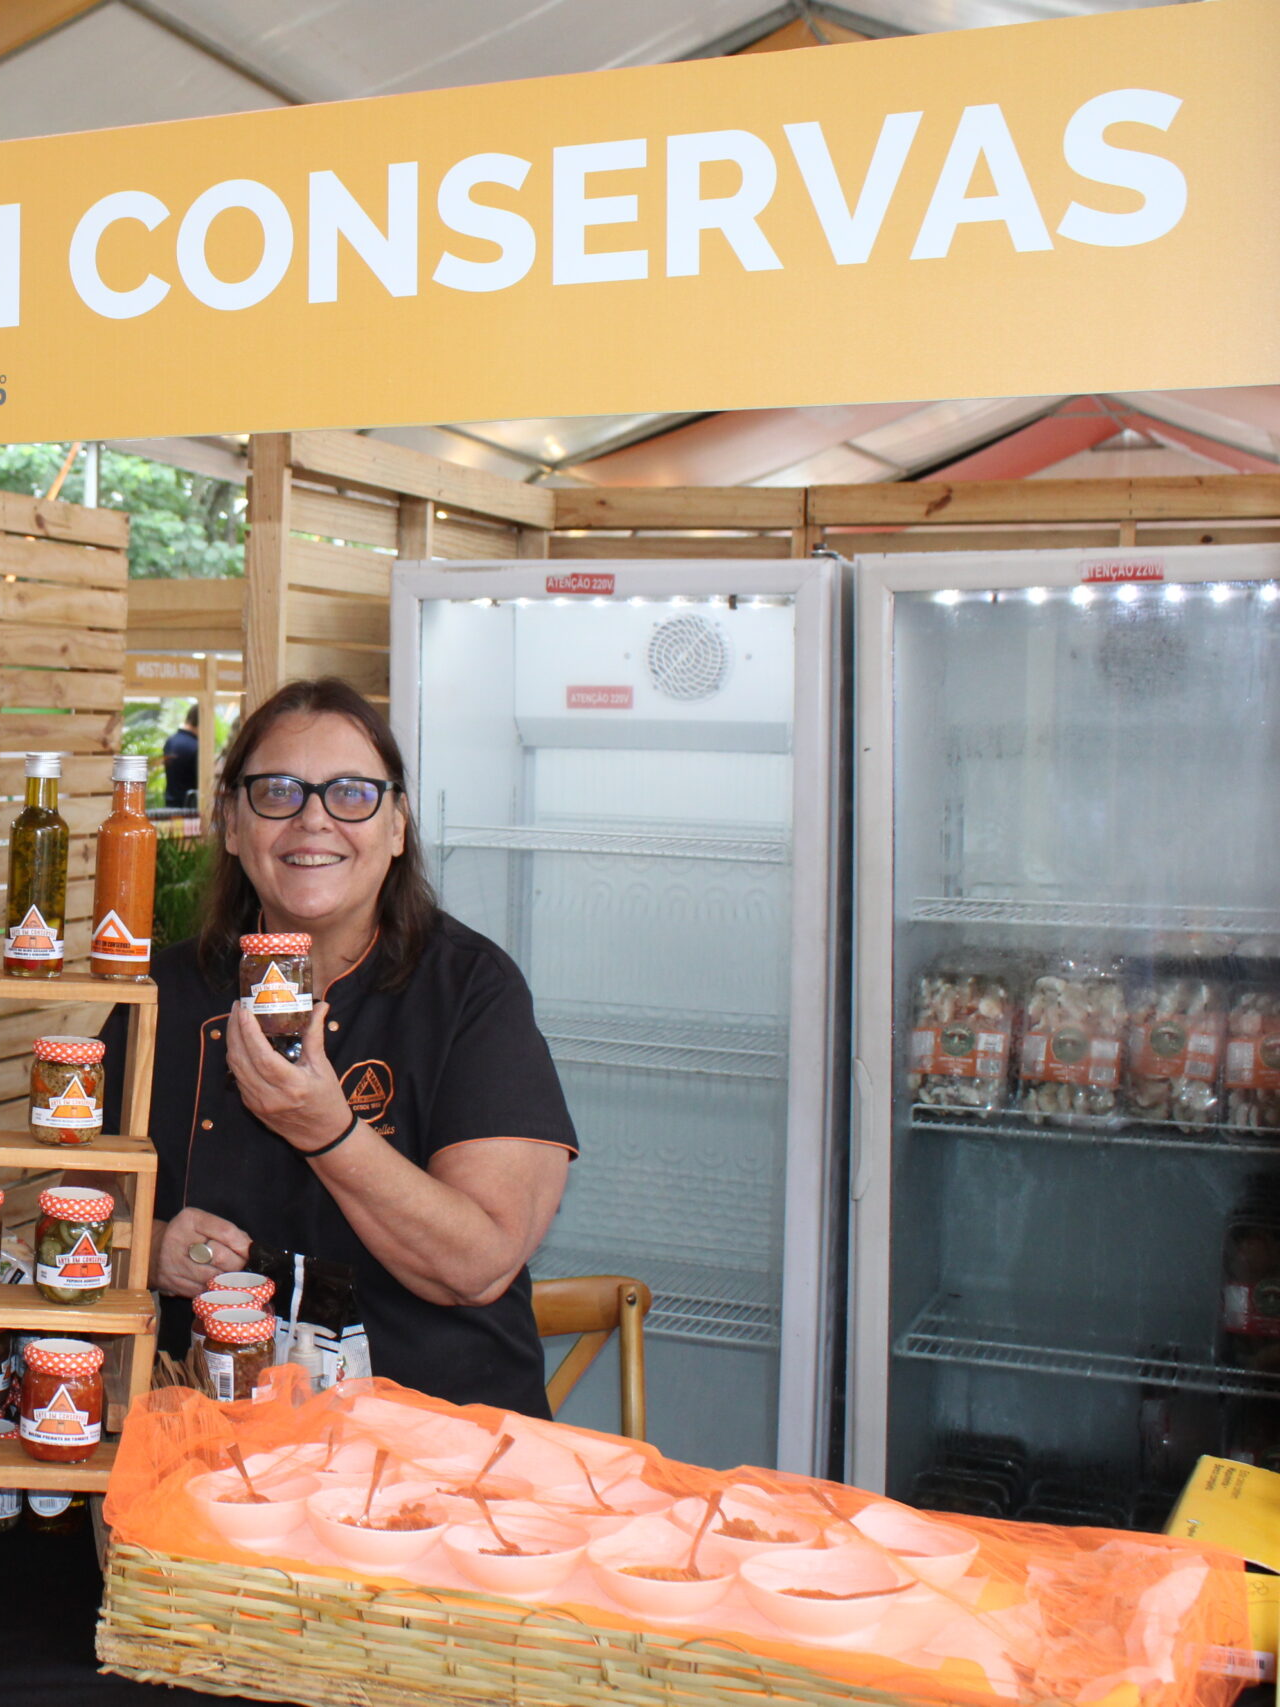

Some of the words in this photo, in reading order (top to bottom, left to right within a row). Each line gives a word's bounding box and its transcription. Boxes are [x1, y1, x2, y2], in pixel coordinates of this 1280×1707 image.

[69, 88, 1189, 320] CONSERVAS
[547, 574, 591, 591] ATENÇÃO
[592, 577, 613, 590] 220V
